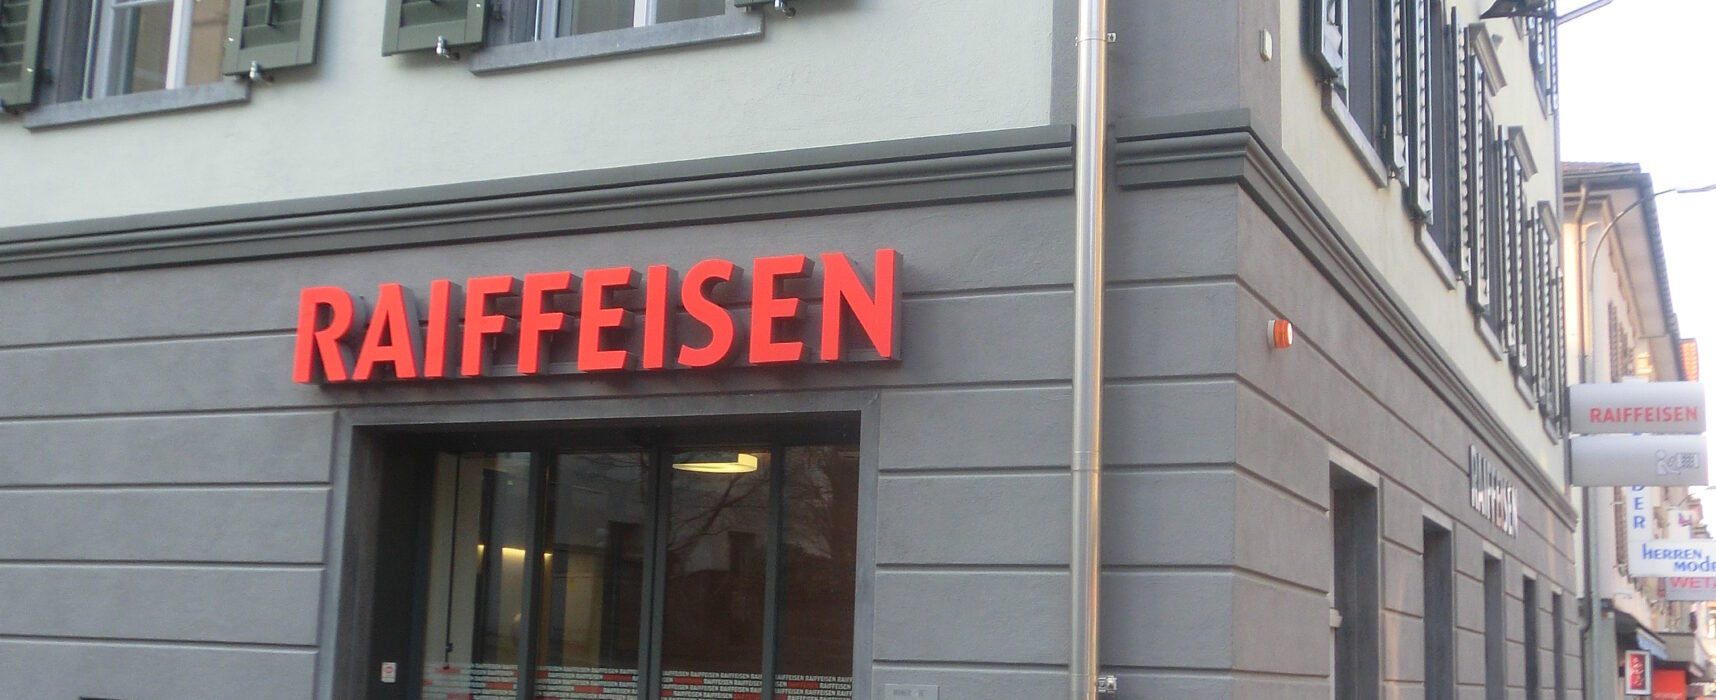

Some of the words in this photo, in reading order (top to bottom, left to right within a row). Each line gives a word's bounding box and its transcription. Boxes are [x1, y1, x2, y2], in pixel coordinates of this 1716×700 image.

[293, 248, 898, 384] RAIFFEISEN
[1589, 406, 1698, 423] RAIFFEISEN
[1670, 577, 1716, 589] WET
